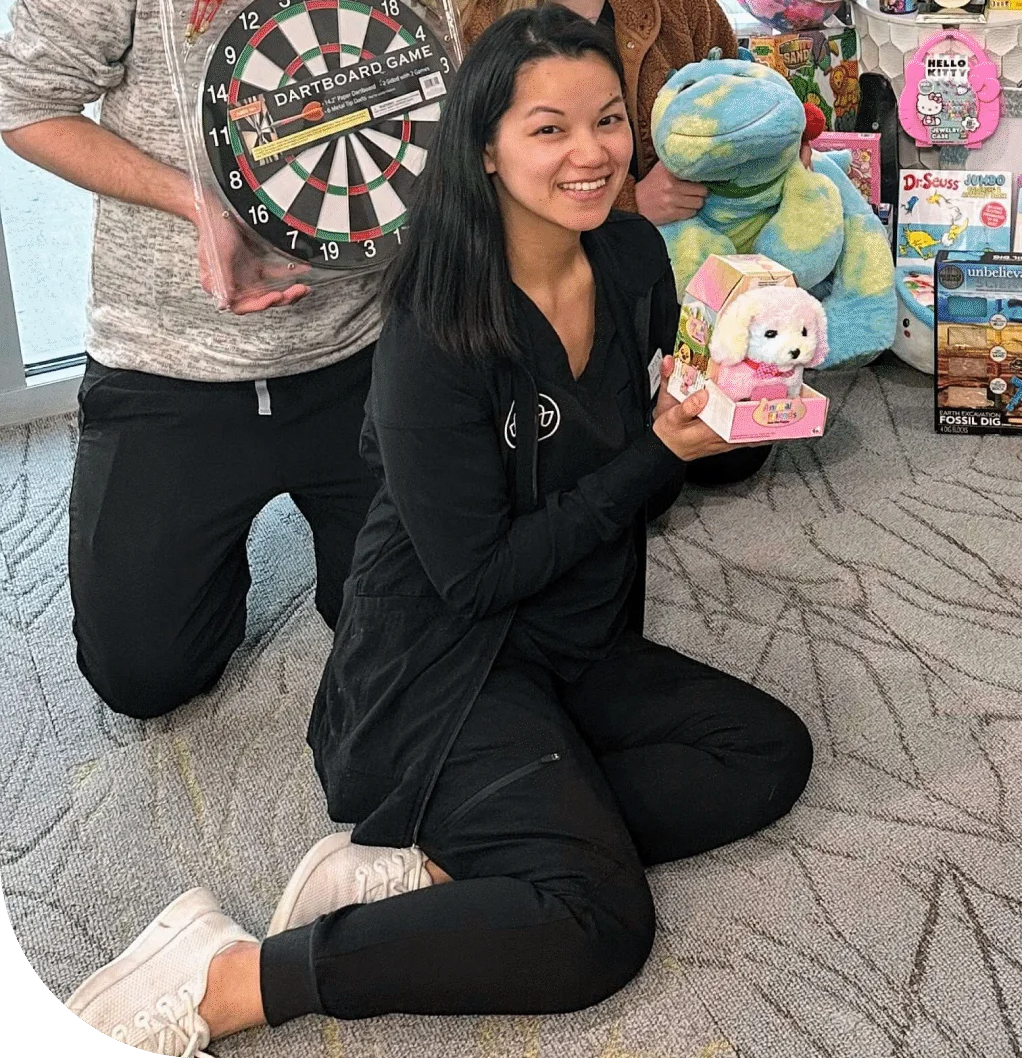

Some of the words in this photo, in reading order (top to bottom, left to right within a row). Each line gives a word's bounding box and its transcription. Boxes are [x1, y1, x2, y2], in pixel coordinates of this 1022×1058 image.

[239, 11, 261, 31] 12
[415, 25, 427, 42] 4
[224, 45, 237, 64] 9
[927, 59, 967, 68] HELLO
[274, 61, 382, 107] DARTBOARD
[386, 44, 433, 69] GAME
[927, 68, 968, 77] KITTY
[208, 84, 228, 104] 14
[209, 128, 231, 147] 11
[229, 171, 243, 189] 8
[248, 205, 270, 224] 16
[286, 230, 299, 250] 7
[363, 239, 377, 258] 3
[319, 241, 340, 262] 19
[939, 415, 978, 425] FOSSIL
[980, 416, 1001, 426] DIG
